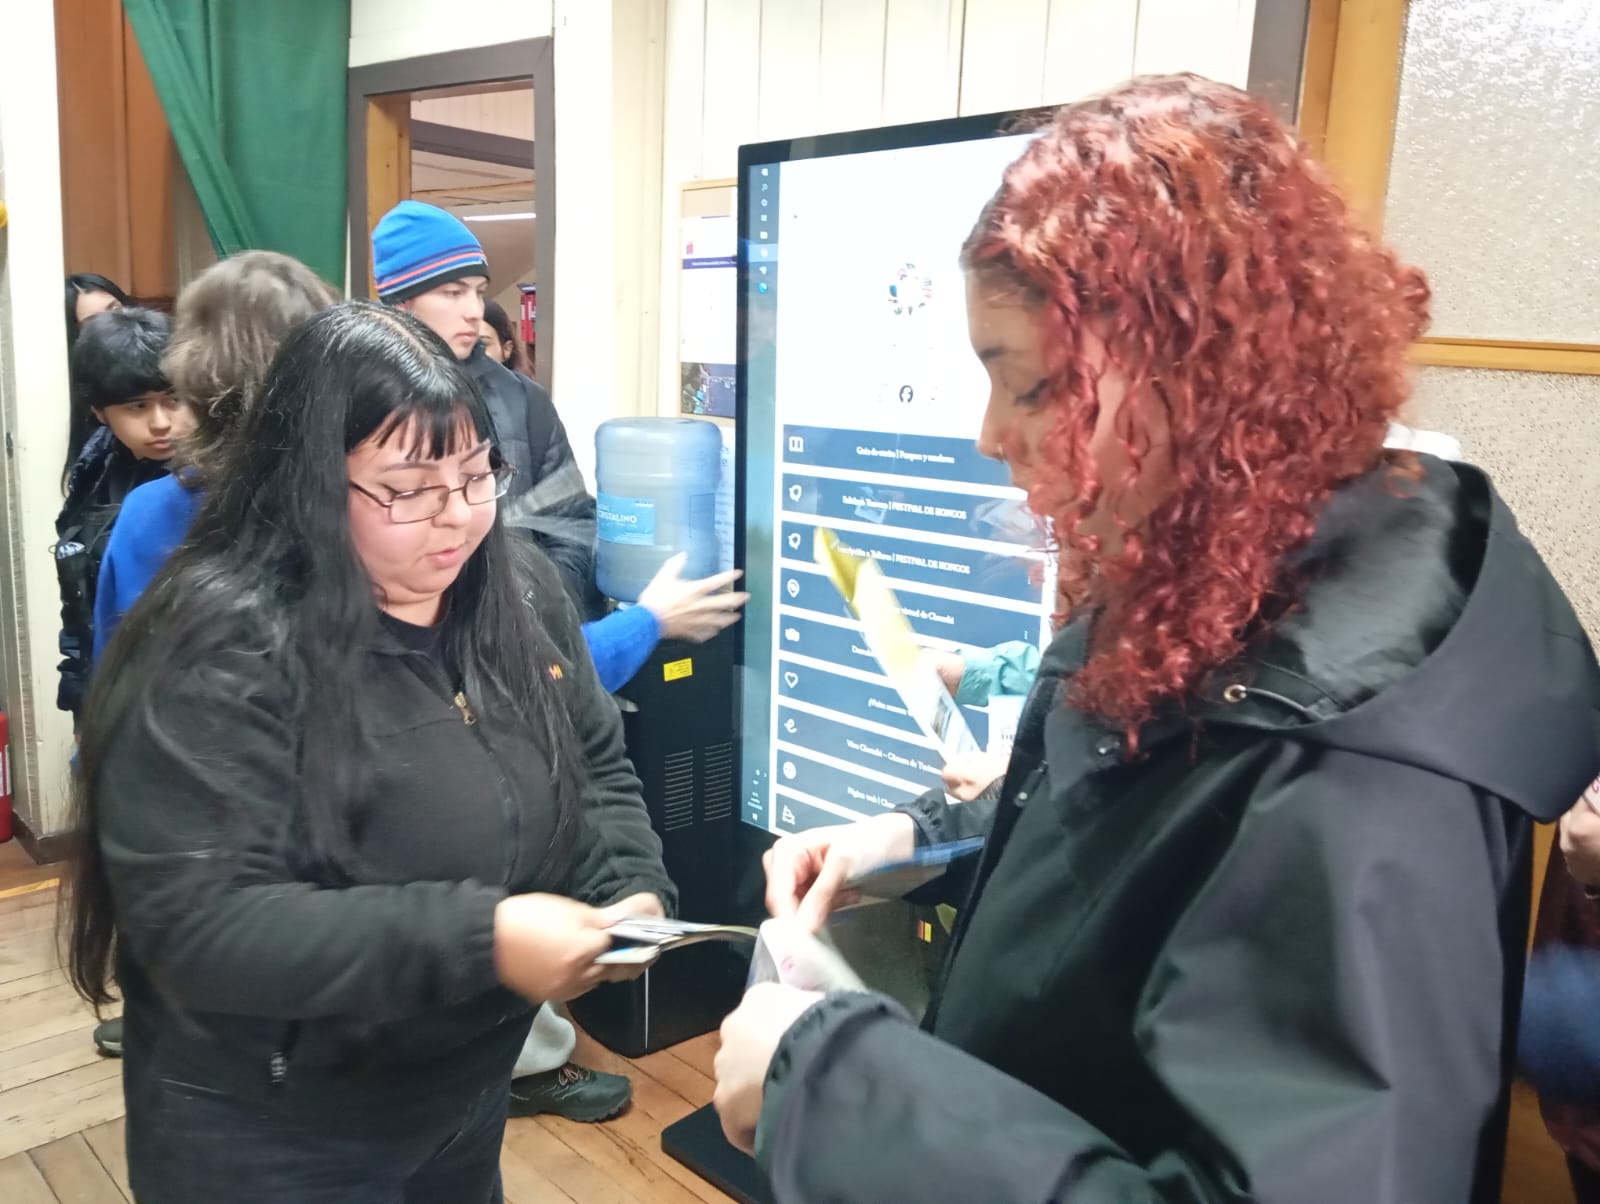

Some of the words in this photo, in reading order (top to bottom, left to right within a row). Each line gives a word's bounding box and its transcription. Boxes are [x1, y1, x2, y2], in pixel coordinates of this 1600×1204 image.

[891, 501, 923, 514] FESTIVAL
[923, 506, 934, 515] DE
[895, 553, 927, 567] FESTIVAL
[927, 559, 938, 569] DE
